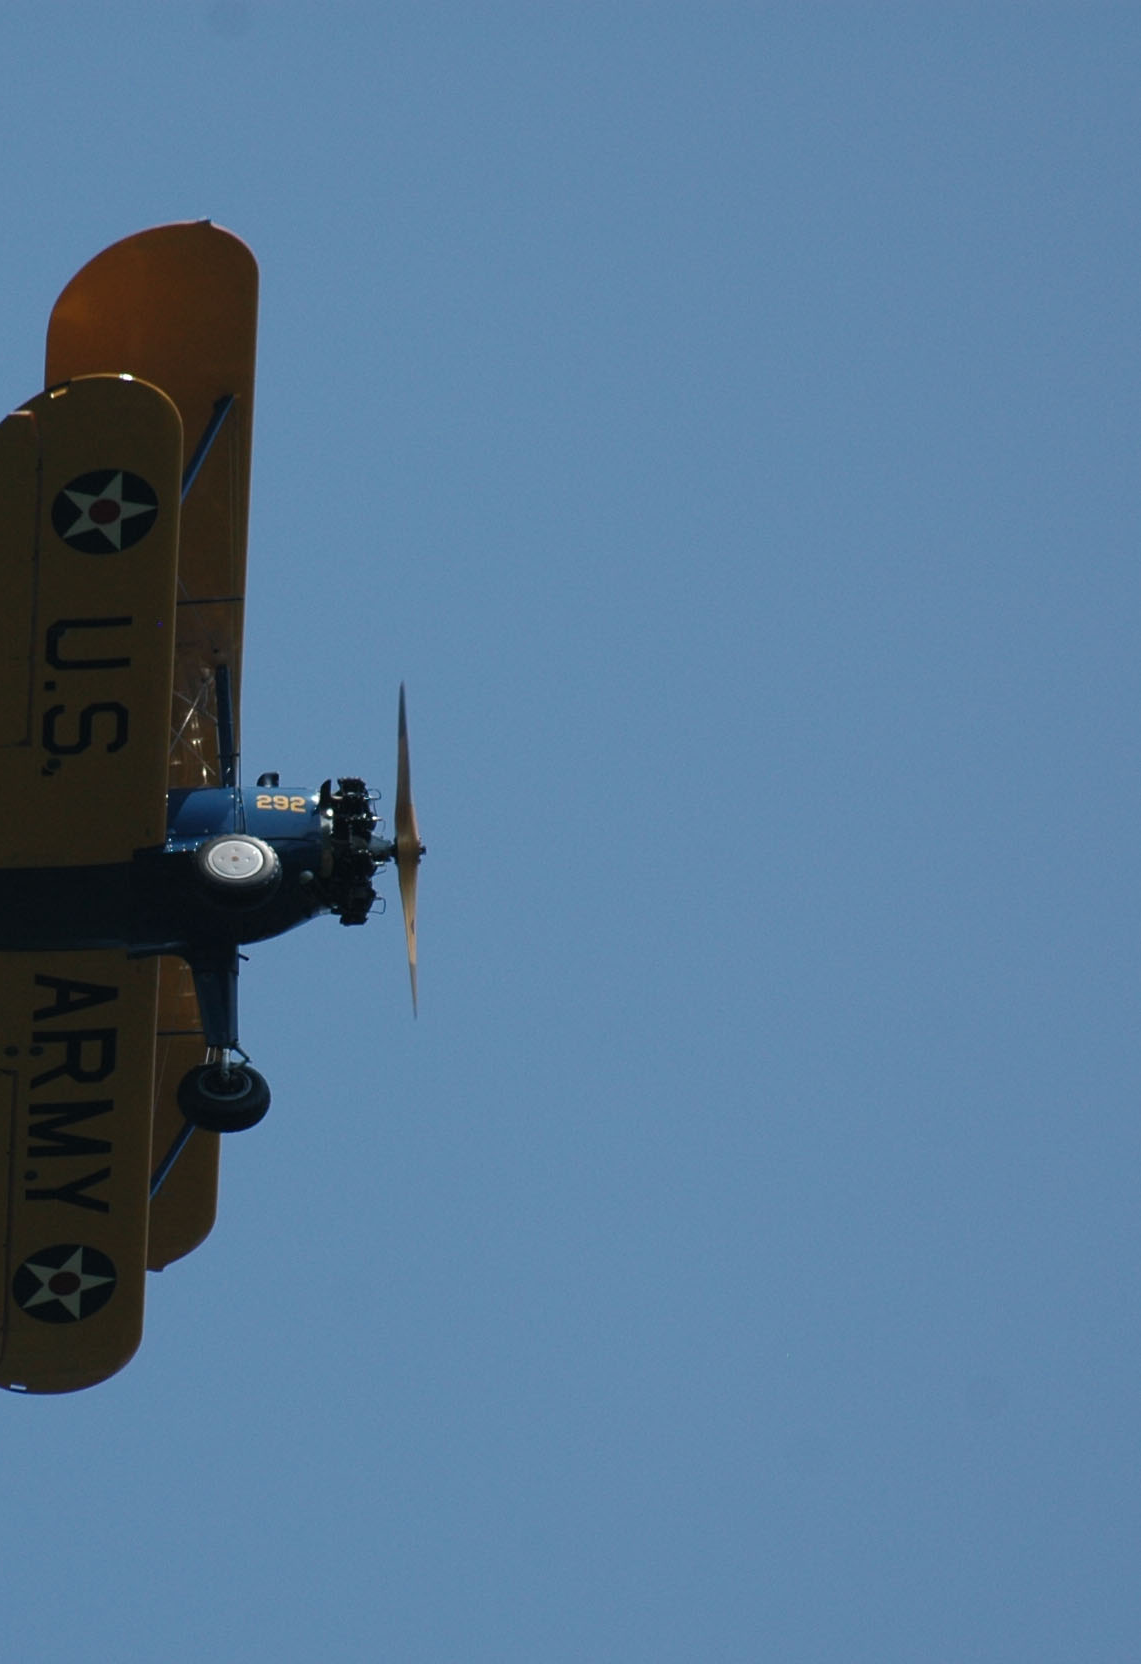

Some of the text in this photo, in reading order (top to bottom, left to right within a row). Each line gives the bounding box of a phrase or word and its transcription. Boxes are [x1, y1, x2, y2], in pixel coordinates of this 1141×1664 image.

[42, 616, 133, 776] U.S.
[256, 794, 306, 813] 292
[24, 974, 119, 1214] ARMY
